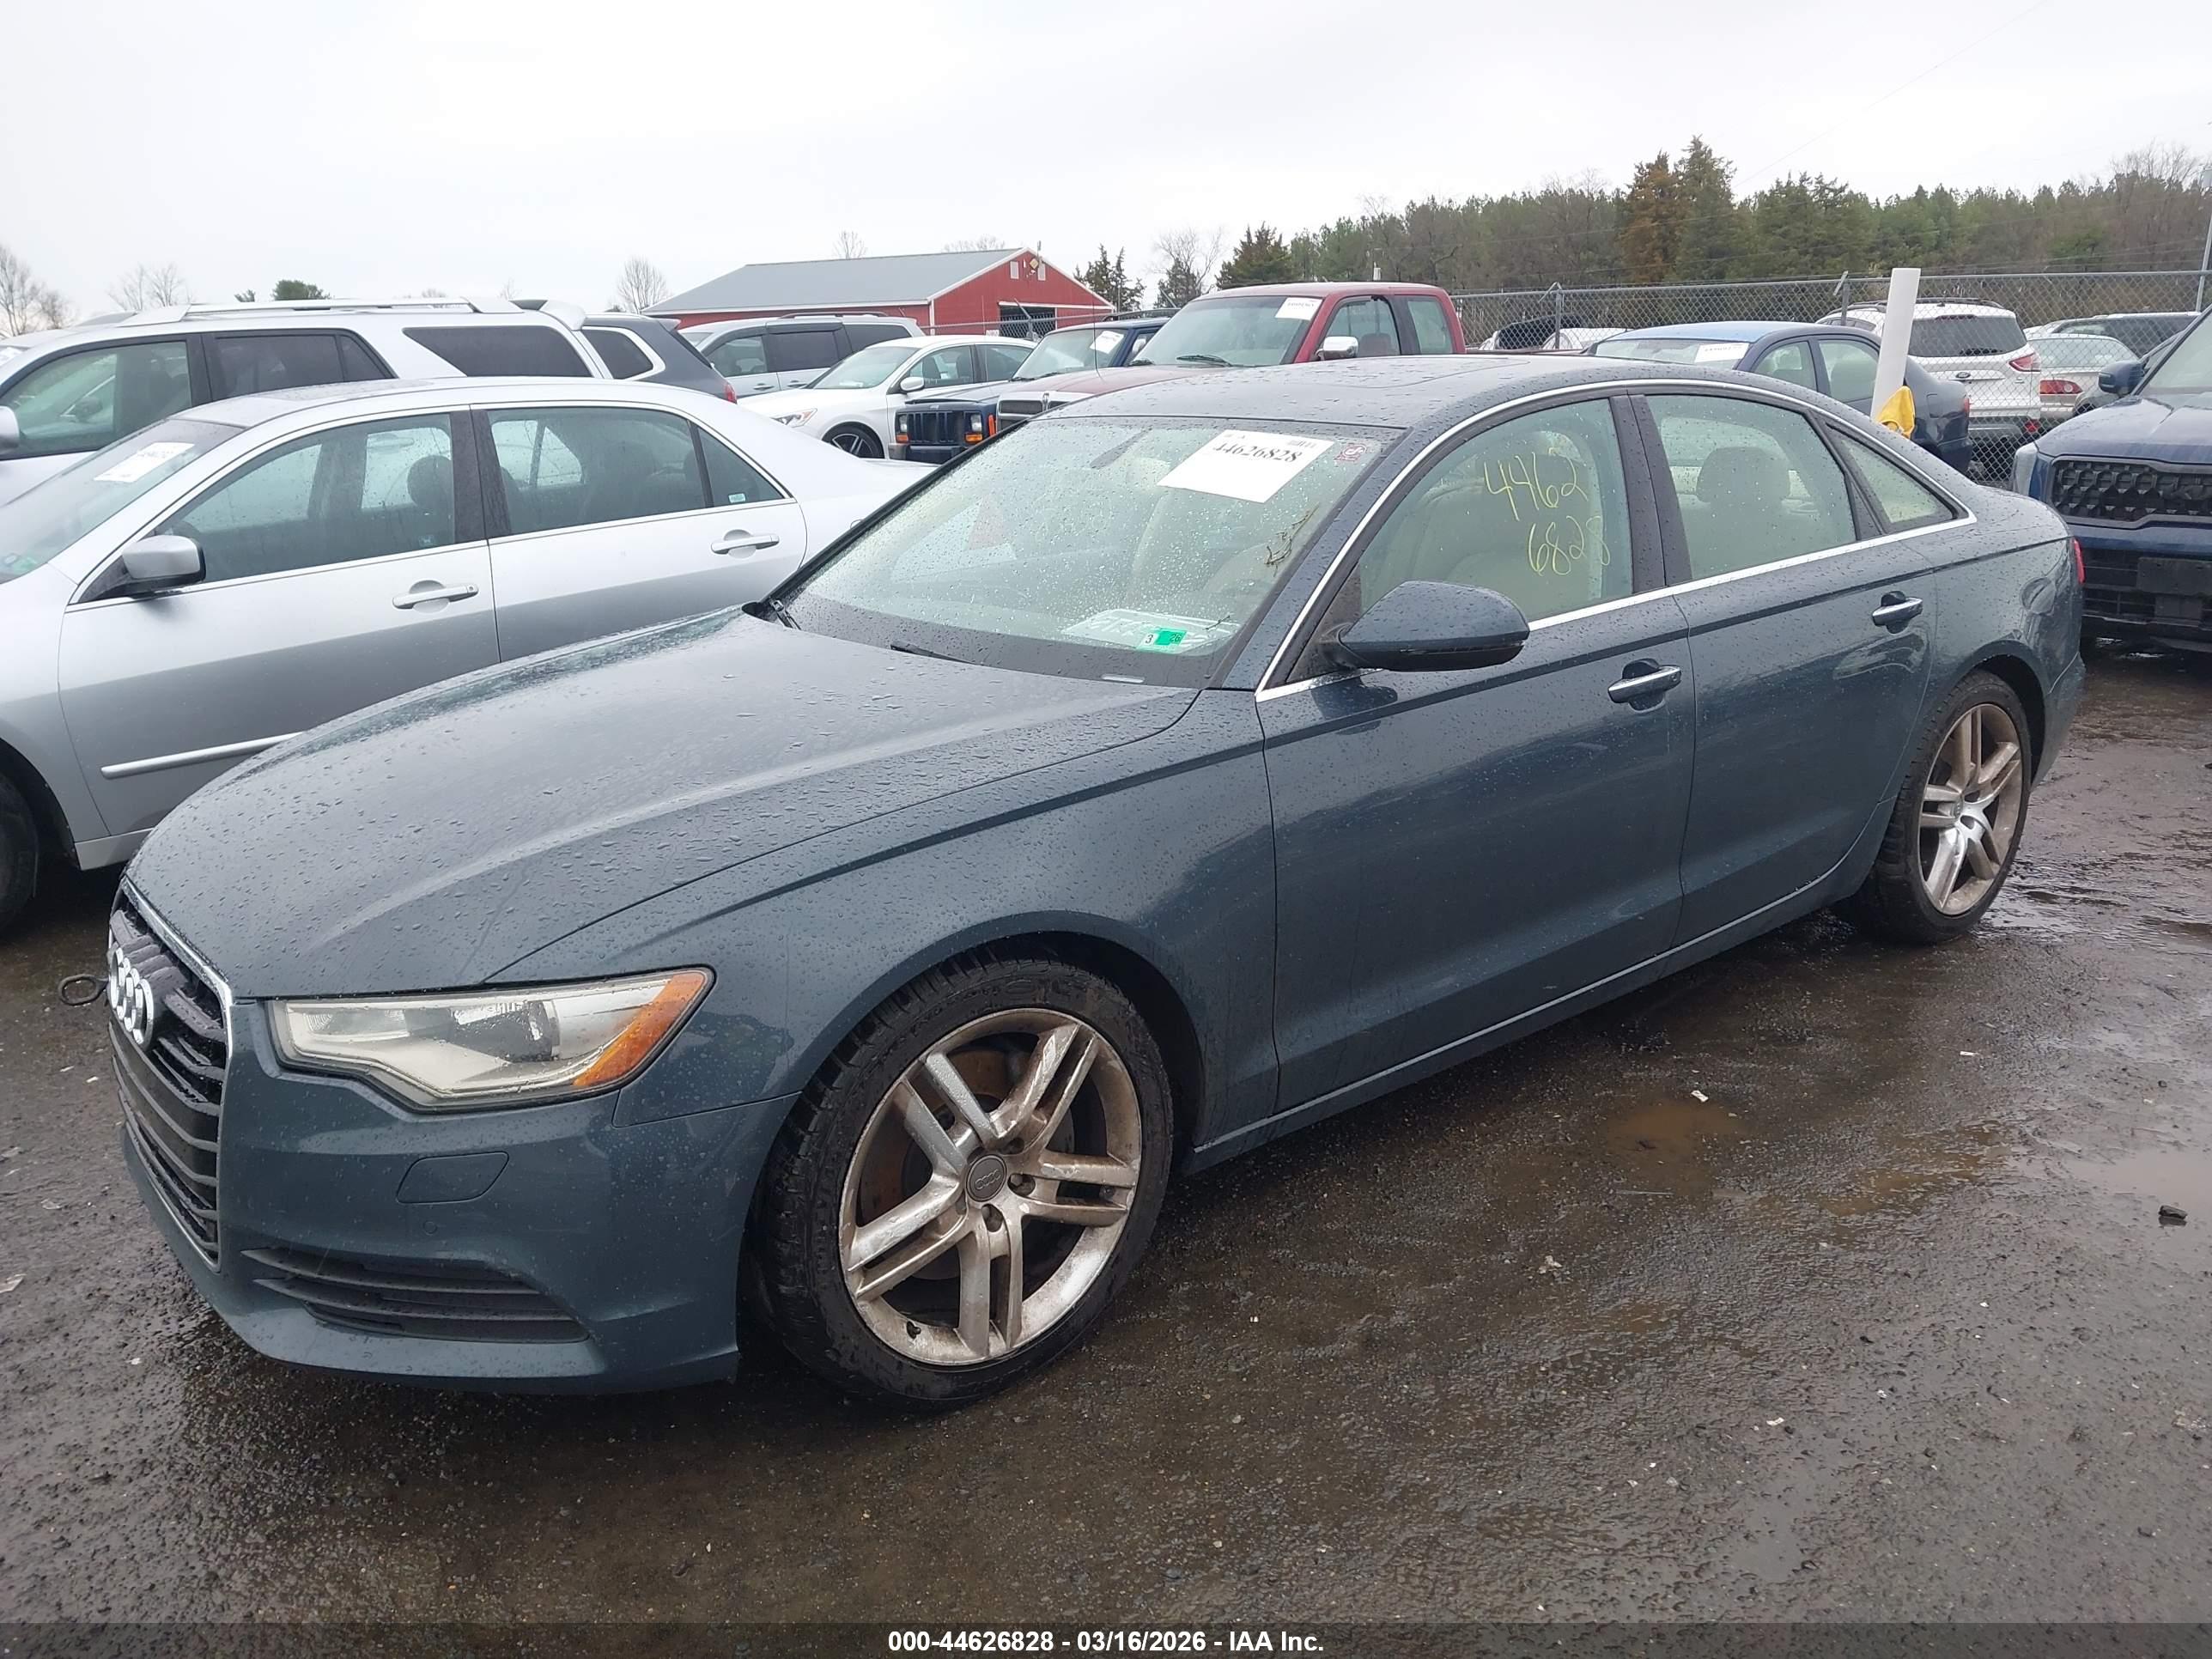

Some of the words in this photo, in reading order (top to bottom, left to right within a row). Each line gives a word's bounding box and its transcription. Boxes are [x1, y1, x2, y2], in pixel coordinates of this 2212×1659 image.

[1483, 447, 1589, 522] 4462
[1527, 515, 1611, 577] 6828
[1145, 634, 1154, 644] 3
[1169, 633, 1182, 643] 26
